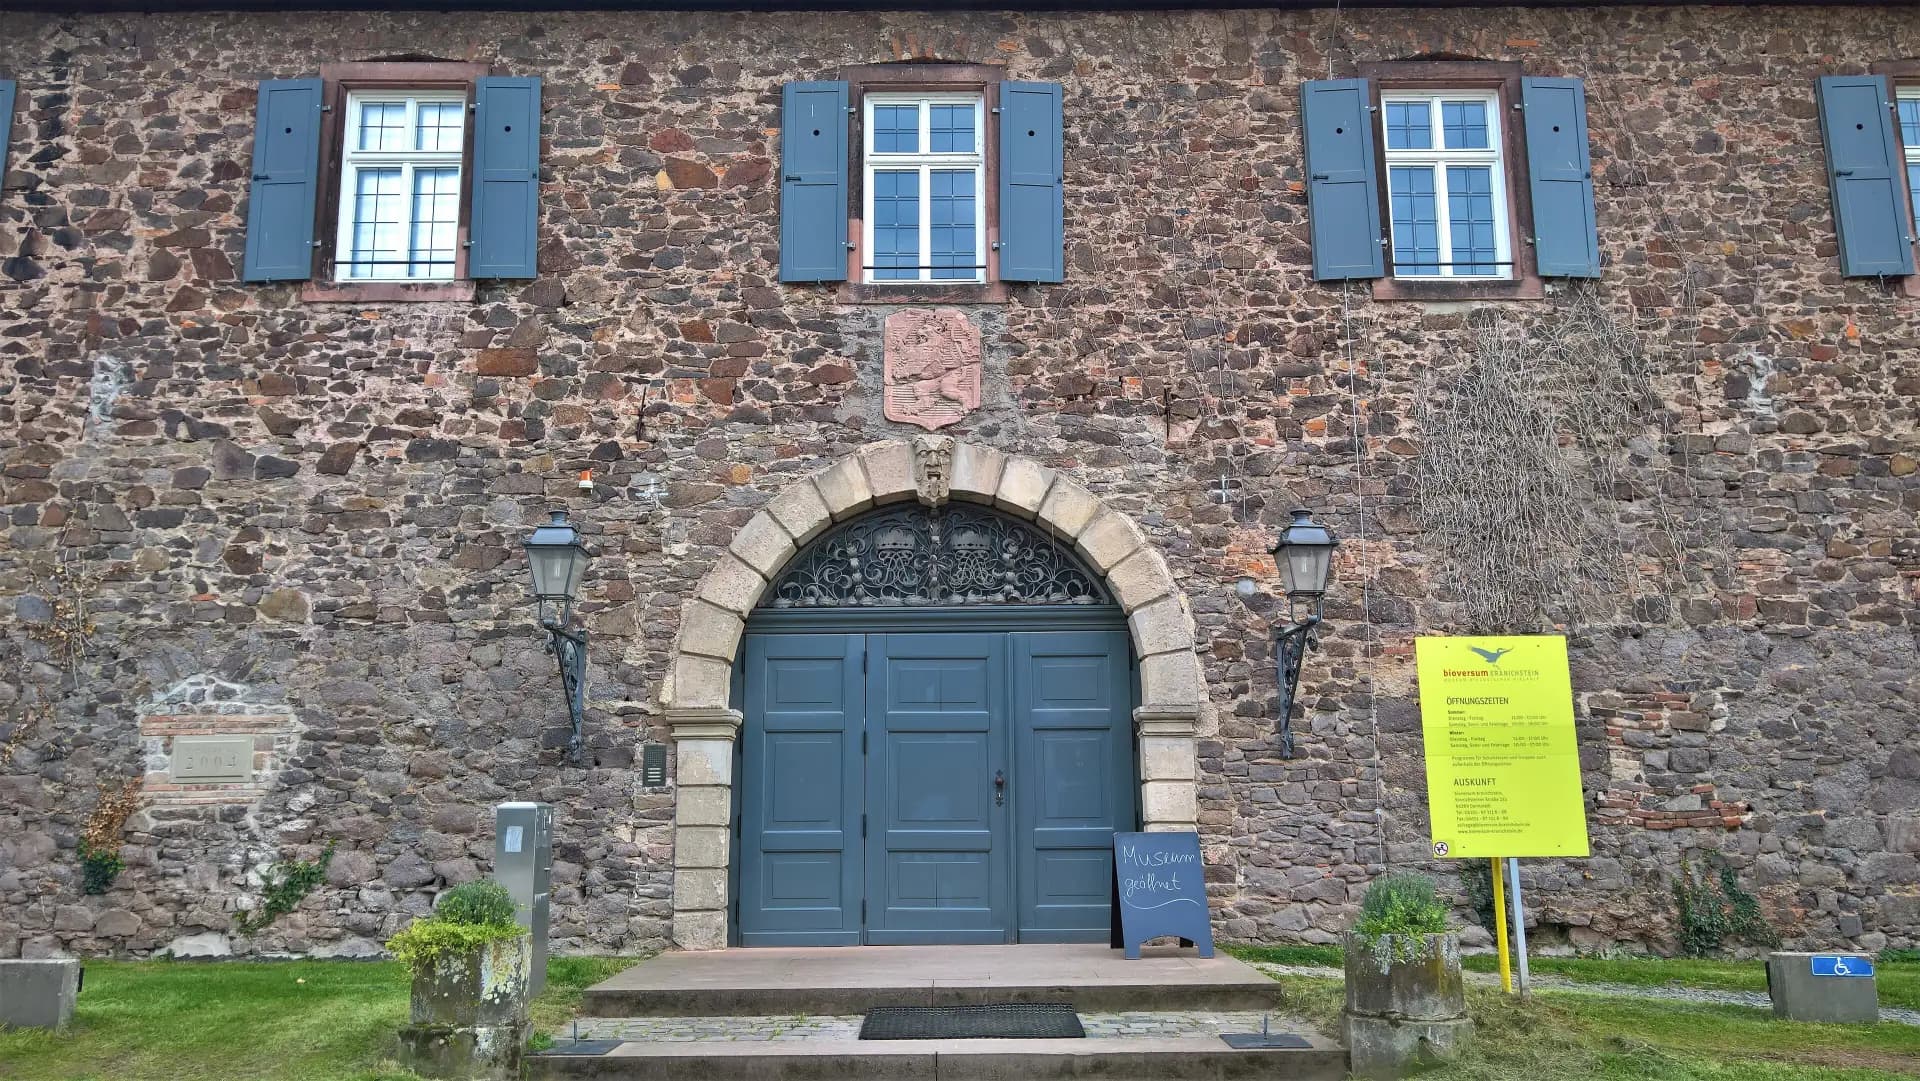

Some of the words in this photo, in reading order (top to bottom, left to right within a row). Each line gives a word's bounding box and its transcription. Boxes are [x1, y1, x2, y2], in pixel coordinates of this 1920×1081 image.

[1443, 669, 1489, 677] bioversum
[1446, 696, 1509, 706] ÖFFNUNGSZEITEN
[1454, 777, 1496, 786] AUSKUNFT
[1123, 845, 1195, 867] Museum
[1124, 872, 1182, 897] geöffnet
